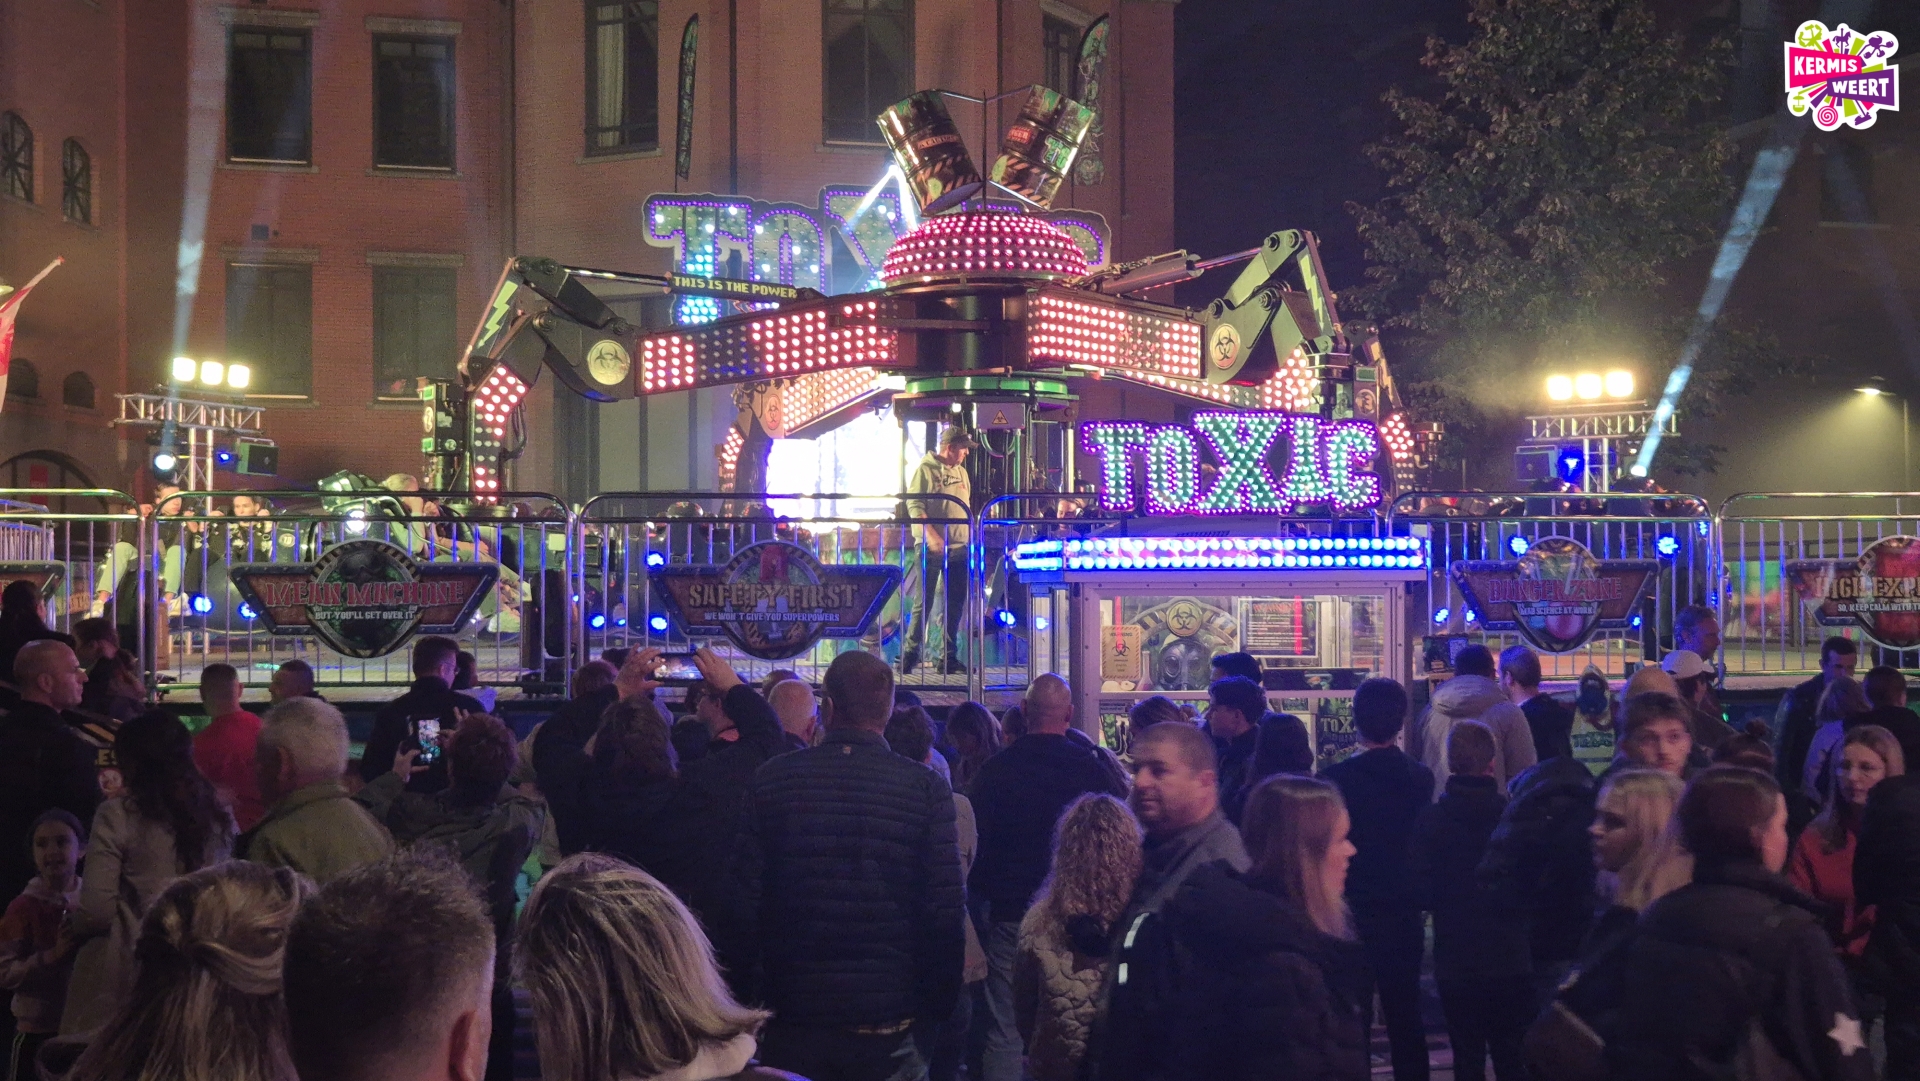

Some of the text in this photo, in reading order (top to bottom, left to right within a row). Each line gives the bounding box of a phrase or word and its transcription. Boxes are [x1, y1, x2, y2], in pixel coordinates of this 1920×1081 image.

[673, 276, 797, 298] THIS IS THE POWER
[1081, 410, 1381, 515] TOXIC
[265, 580, 465, 607] MEAN MACHINE
[688, 583, 859, 608] SAFETY FIRST
[1488, 576, 1622, 603] DANGER ZONE
[1815, 576, 1920, 599] HIGH EXP
[315, 611, 332, 620] BUT
[333, 611, 364, 620] YOU'LL
[364, 611, 382, 619] GET
[382, 611, 404, 619] OVER
[704, 612, 717, 620] WE
[746, 612, 763, 620] GIVE
[766, 612, 781, 620] YOU
[782, 613, 840, 621] SUPERPOWERS
[1536, 607, 1563, 615] SCIENCE
[1563, 606, 1573, 614] AT
[1849, 603, 1870, 612] KEEP
[1870, 602, 1890, 611] CALM
[1891, 602, 1912, 611] WITH
[1320, 715, 1357, 734] TOX
